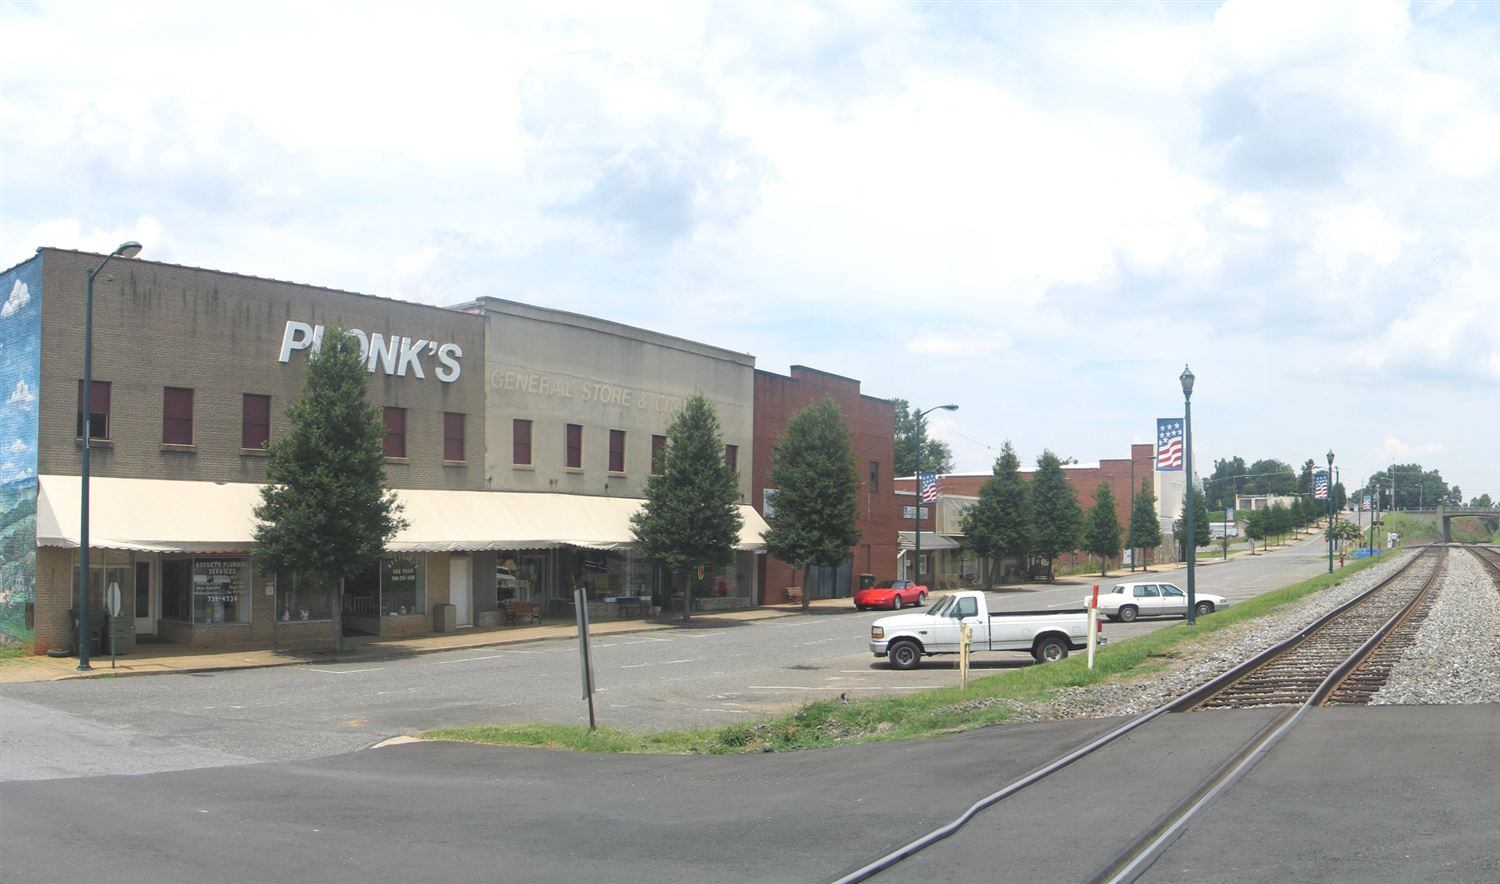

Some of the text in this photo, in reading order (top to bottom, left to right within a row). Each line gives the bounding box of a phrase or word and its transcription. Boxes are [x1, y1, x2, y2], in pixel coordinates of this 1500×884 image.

[278, 320, 463, 383] PLONK'S
[491, 369, 574, 398] GENERAL
[581, 382, 631, 407] STORE
